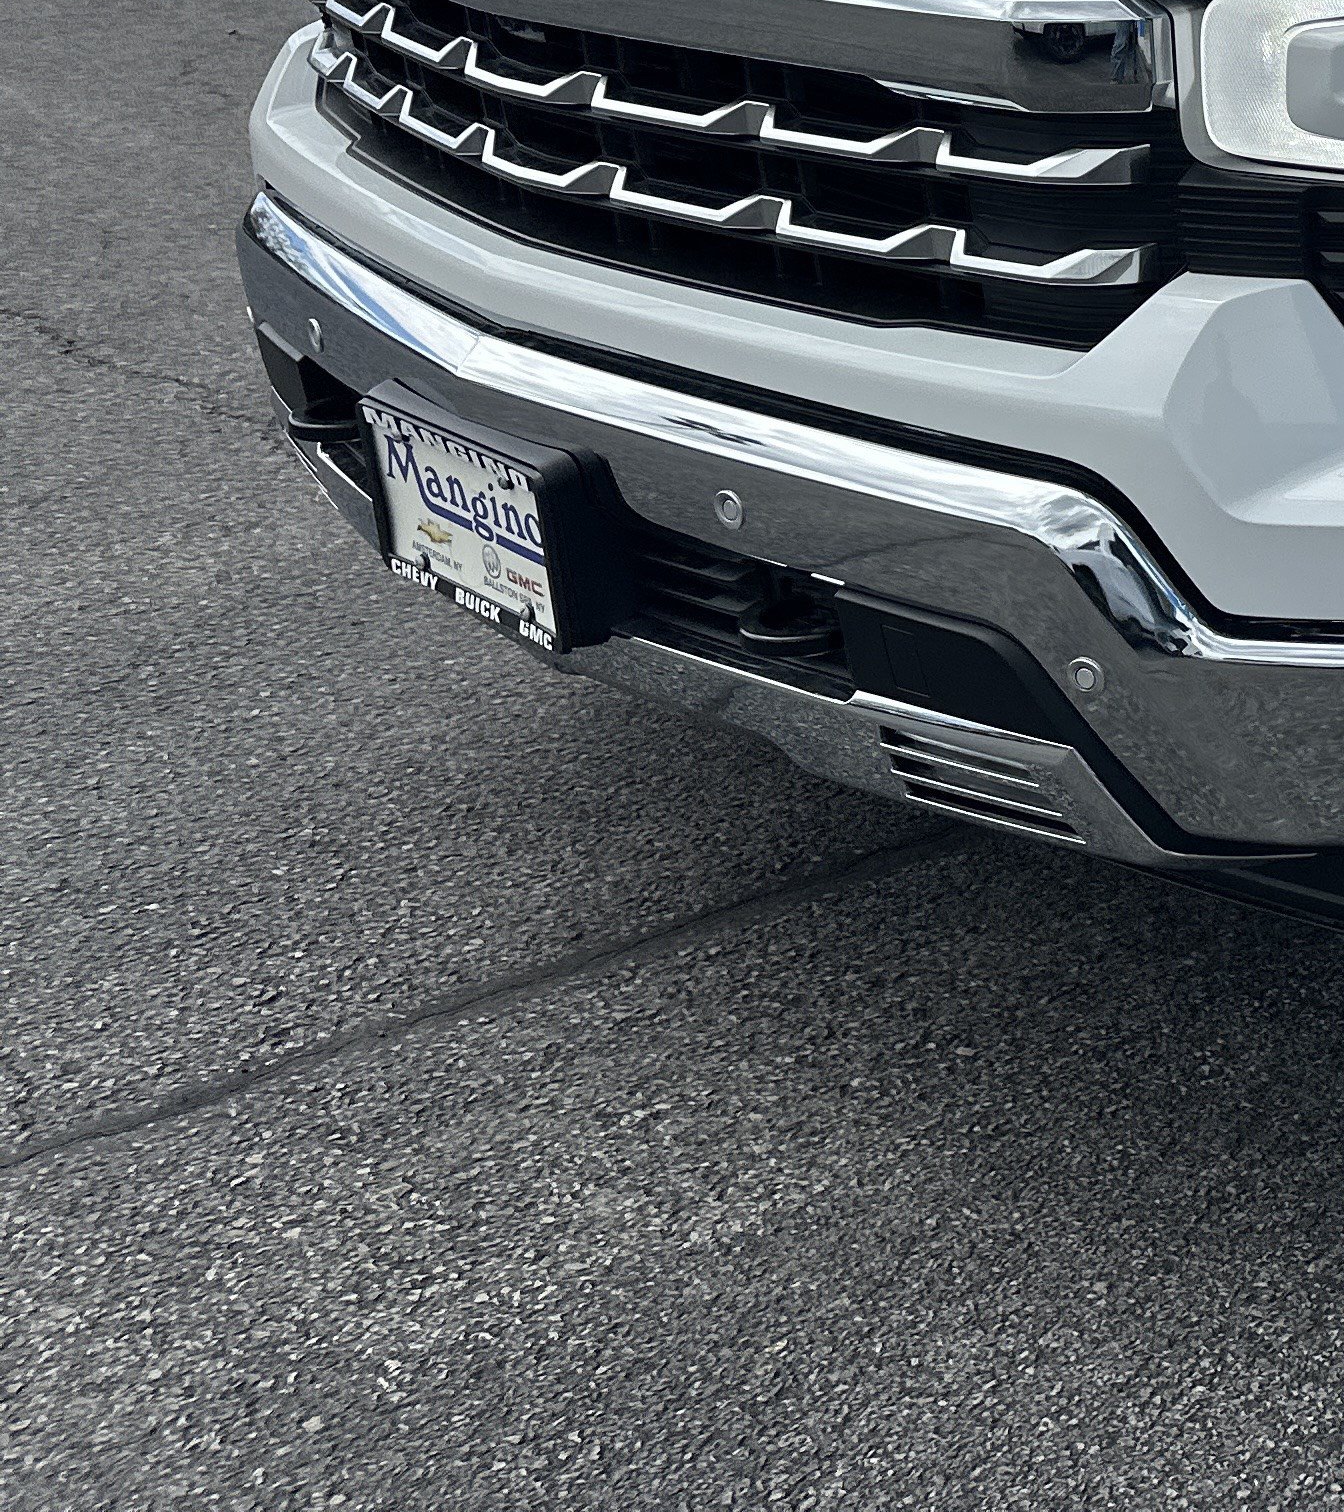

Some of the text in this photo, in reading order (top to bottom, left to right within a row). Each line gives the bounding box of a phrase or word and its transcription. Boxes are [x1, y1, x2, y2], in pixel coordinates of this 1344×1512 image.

[362, 405, 530, 492] MANGINO
[384, 434, 542, 548] Mangino
[390, 557, 553, 651] CHEVY BUICK GMC
[506, 567, 545, 597] GMC
